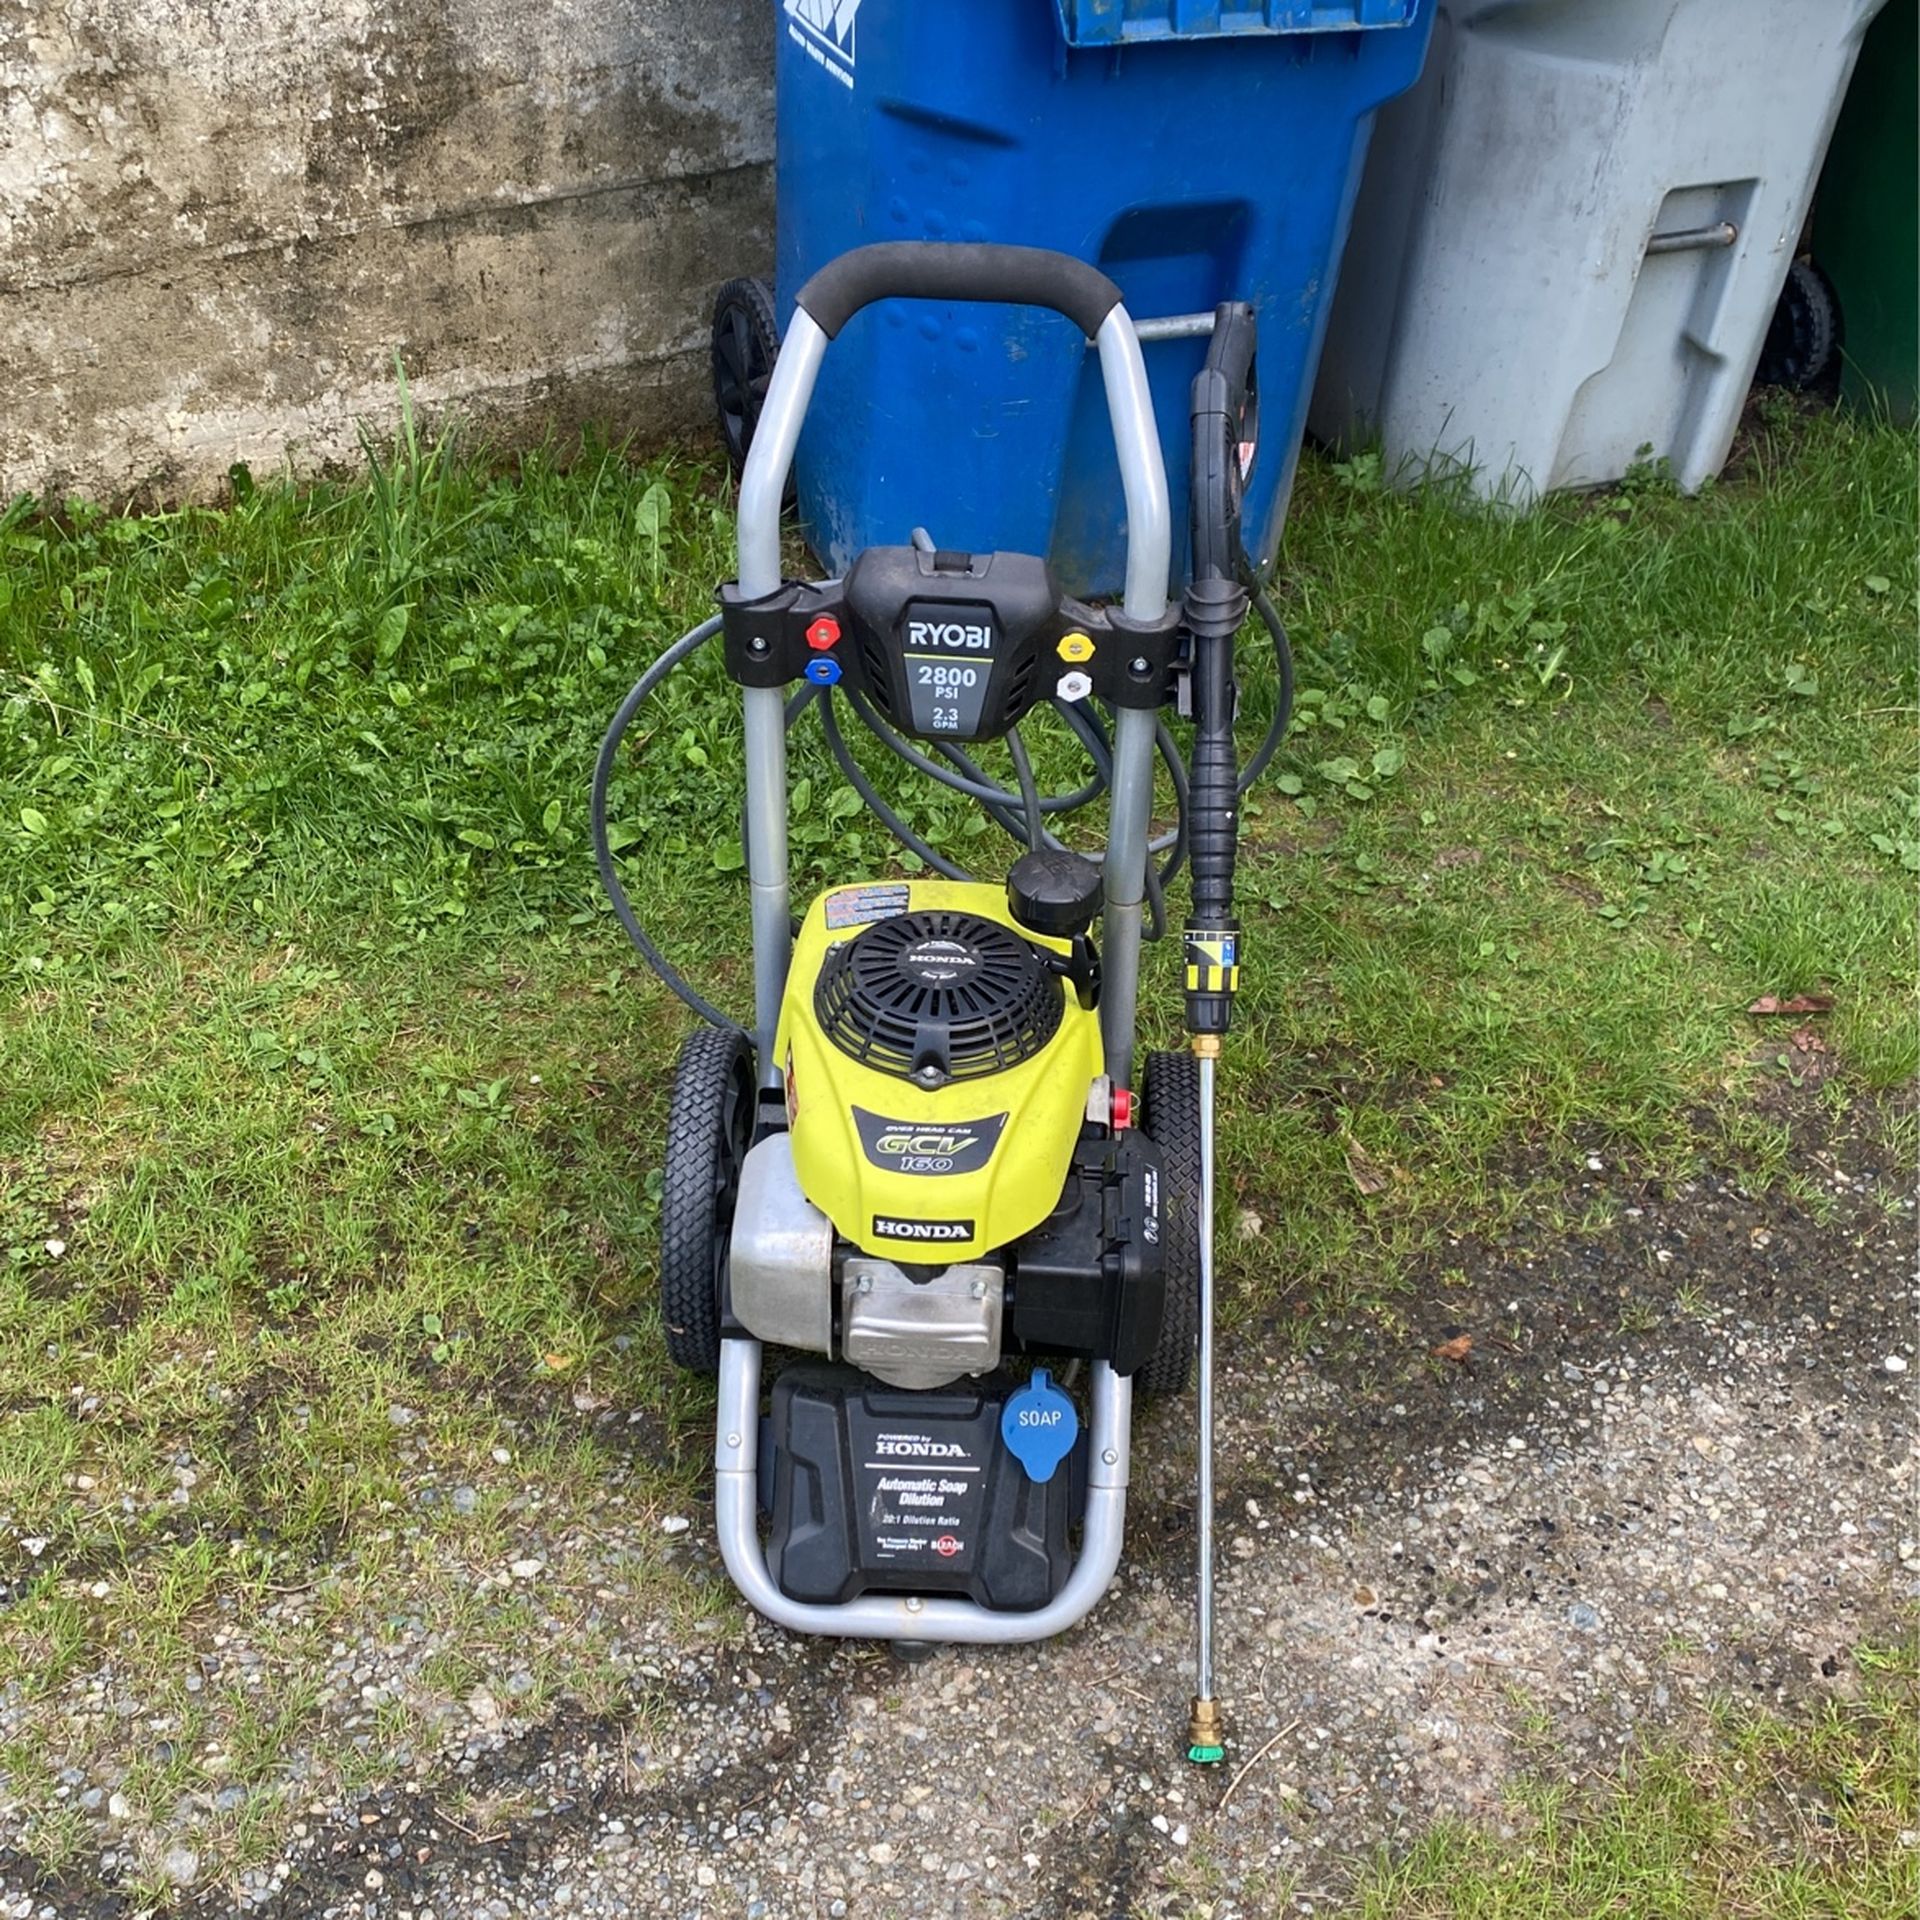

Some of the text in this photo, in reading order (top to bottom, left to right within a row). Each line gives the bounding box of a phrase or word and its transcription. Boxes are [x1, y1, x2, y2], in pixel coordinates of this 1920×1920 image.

[909, 621, 991, 649] RYOBI
[918, 665, 977, 687] 2800
[935, 686, 958, 699] PSI
[932, 706, 958, 721] 2.3
[932, 721, 958, 730] GPM
[909, 954, 976, 965] HONDA
[885, 1125, 972, 1135] OVER HEAD CAM
[876, 1134, 980, 1156] GCV
[900, 1156, 954, 1172] 160
[875, 1220, 970, 1238] HONDA
[859, 1342, 978, 1362] HONDA
[1019, 1410, 1062, 1427] SOAP
[877, 1477, 968, 1496] Automatic Soap
[899, 1492, 945, 1506] Dilution
[902, 1514, 936, 1526] Dilution
[937, 1516, 960, 1526] Ratio
